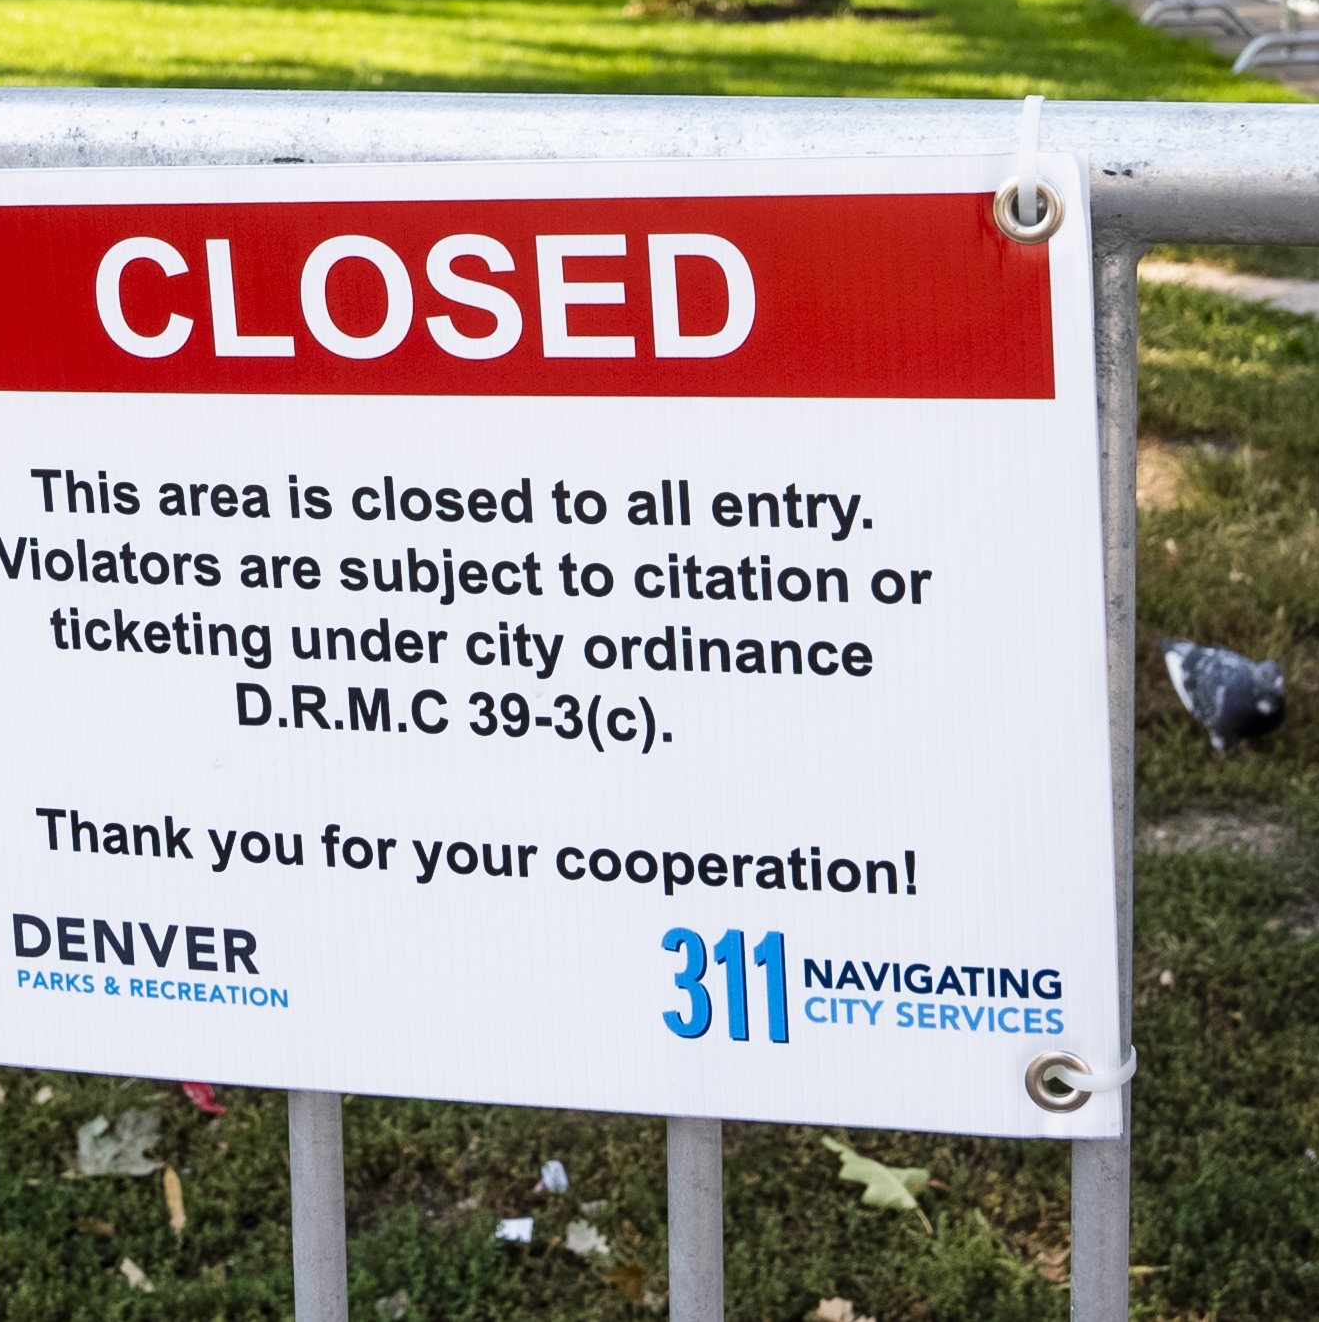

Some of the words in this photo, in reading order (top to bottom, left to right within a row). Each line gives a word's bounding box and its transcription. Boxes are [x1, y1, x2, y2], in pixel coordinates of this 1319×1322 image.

[95, 233, 756, 360] CLOSED
[30, 468, 141, 516] This
[158, 482, 271, 519] area
[288, 474, 333, 520] is
[351, 475, 534, 524] closed
[551, 479, 608, 525] to
[627, 479, 691, 526] all
[711, 482, 873, 542] entry.
[240, 554, 322, 591] are
[339, 547, 544, 606] subject
[558, 552, 614, 598] to
[634, 552, 849, 603] citation
[870, 568, 933, 605] or
[49, 607, 272, 670] ticketing
[291, 617, 449, 664] under
[465, 620, 564, 680] city
[583, 625, 873, 678] ordinance
[235, 682, 449, 735] D.R.M.C
[468, 691, 673, 755] 39-3(c).
[35, 807, 194, 860] Thank
[207, 828, 304, 873] you
[320, 823, 398, 871] for
[411, 839, 539, 885] your
[555, 845, 917, 897] cooperation!
[12, 913, 260, 975] DENVER
[803, 958, 1063, 1000] NAVIGATING
[17, 969, 95, 994] PARKS
[103, 975, 121, 996] &
[129, 978, 289, 1008] RECREATION
[660, 927, 790, 1045] 311
[804, 996, 884, 1026] CITY
[896, 1001, 1065, 1035] SERVICES
